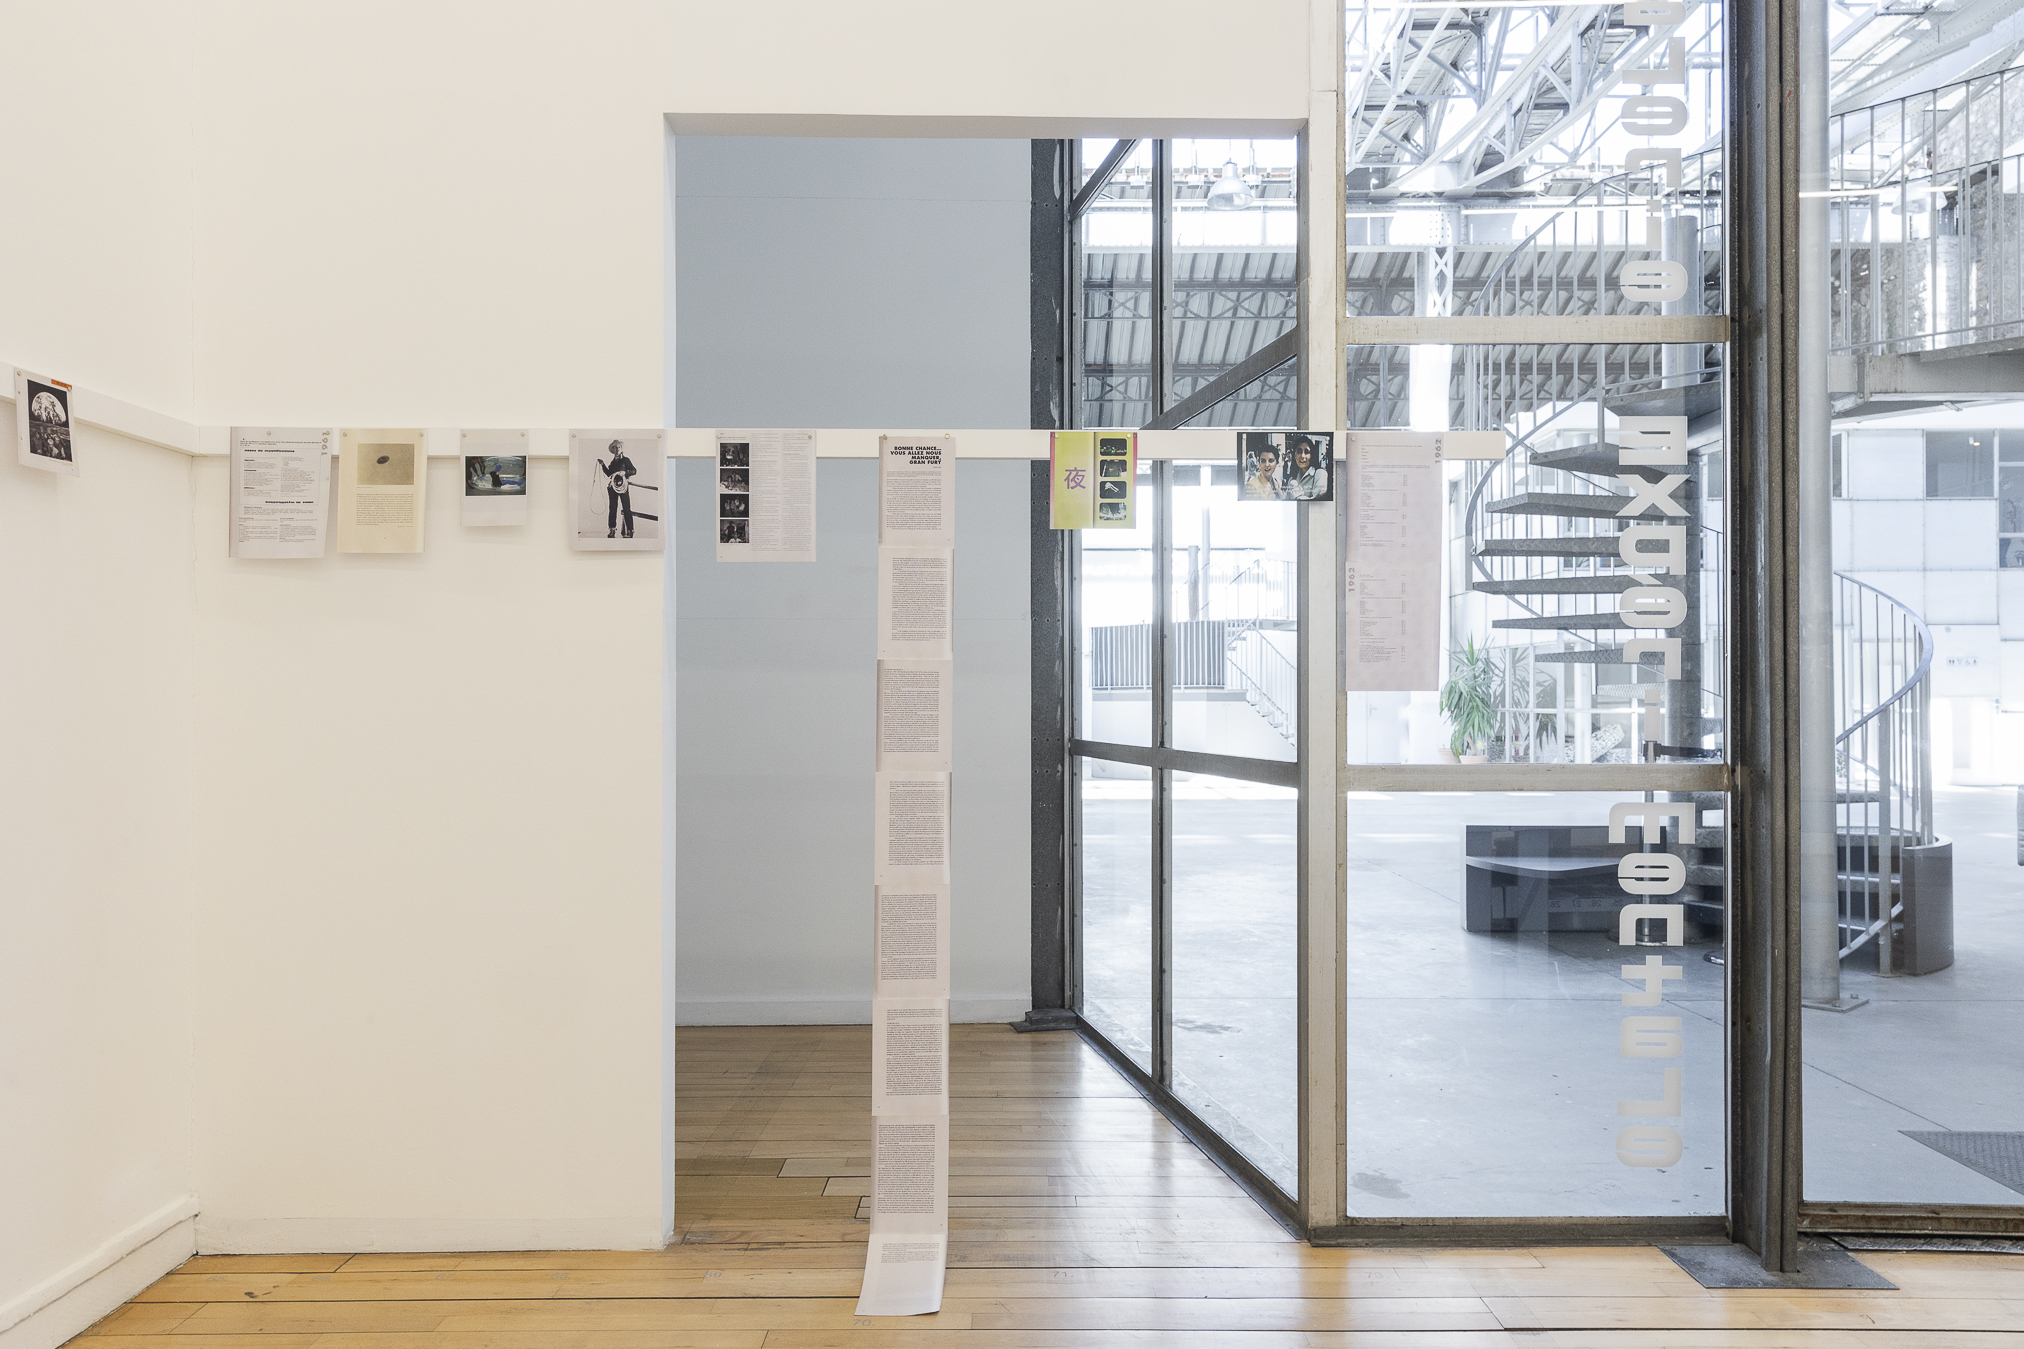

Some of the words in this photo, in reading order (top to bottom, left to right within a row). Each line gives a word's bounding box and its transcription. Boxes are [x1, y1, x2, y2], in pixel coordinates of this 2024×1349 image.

[1434, 438, 1442, 464] 1962
[1064, 467, 1086, 489] 夜
[1348, 566, 1356, 593] 1962
